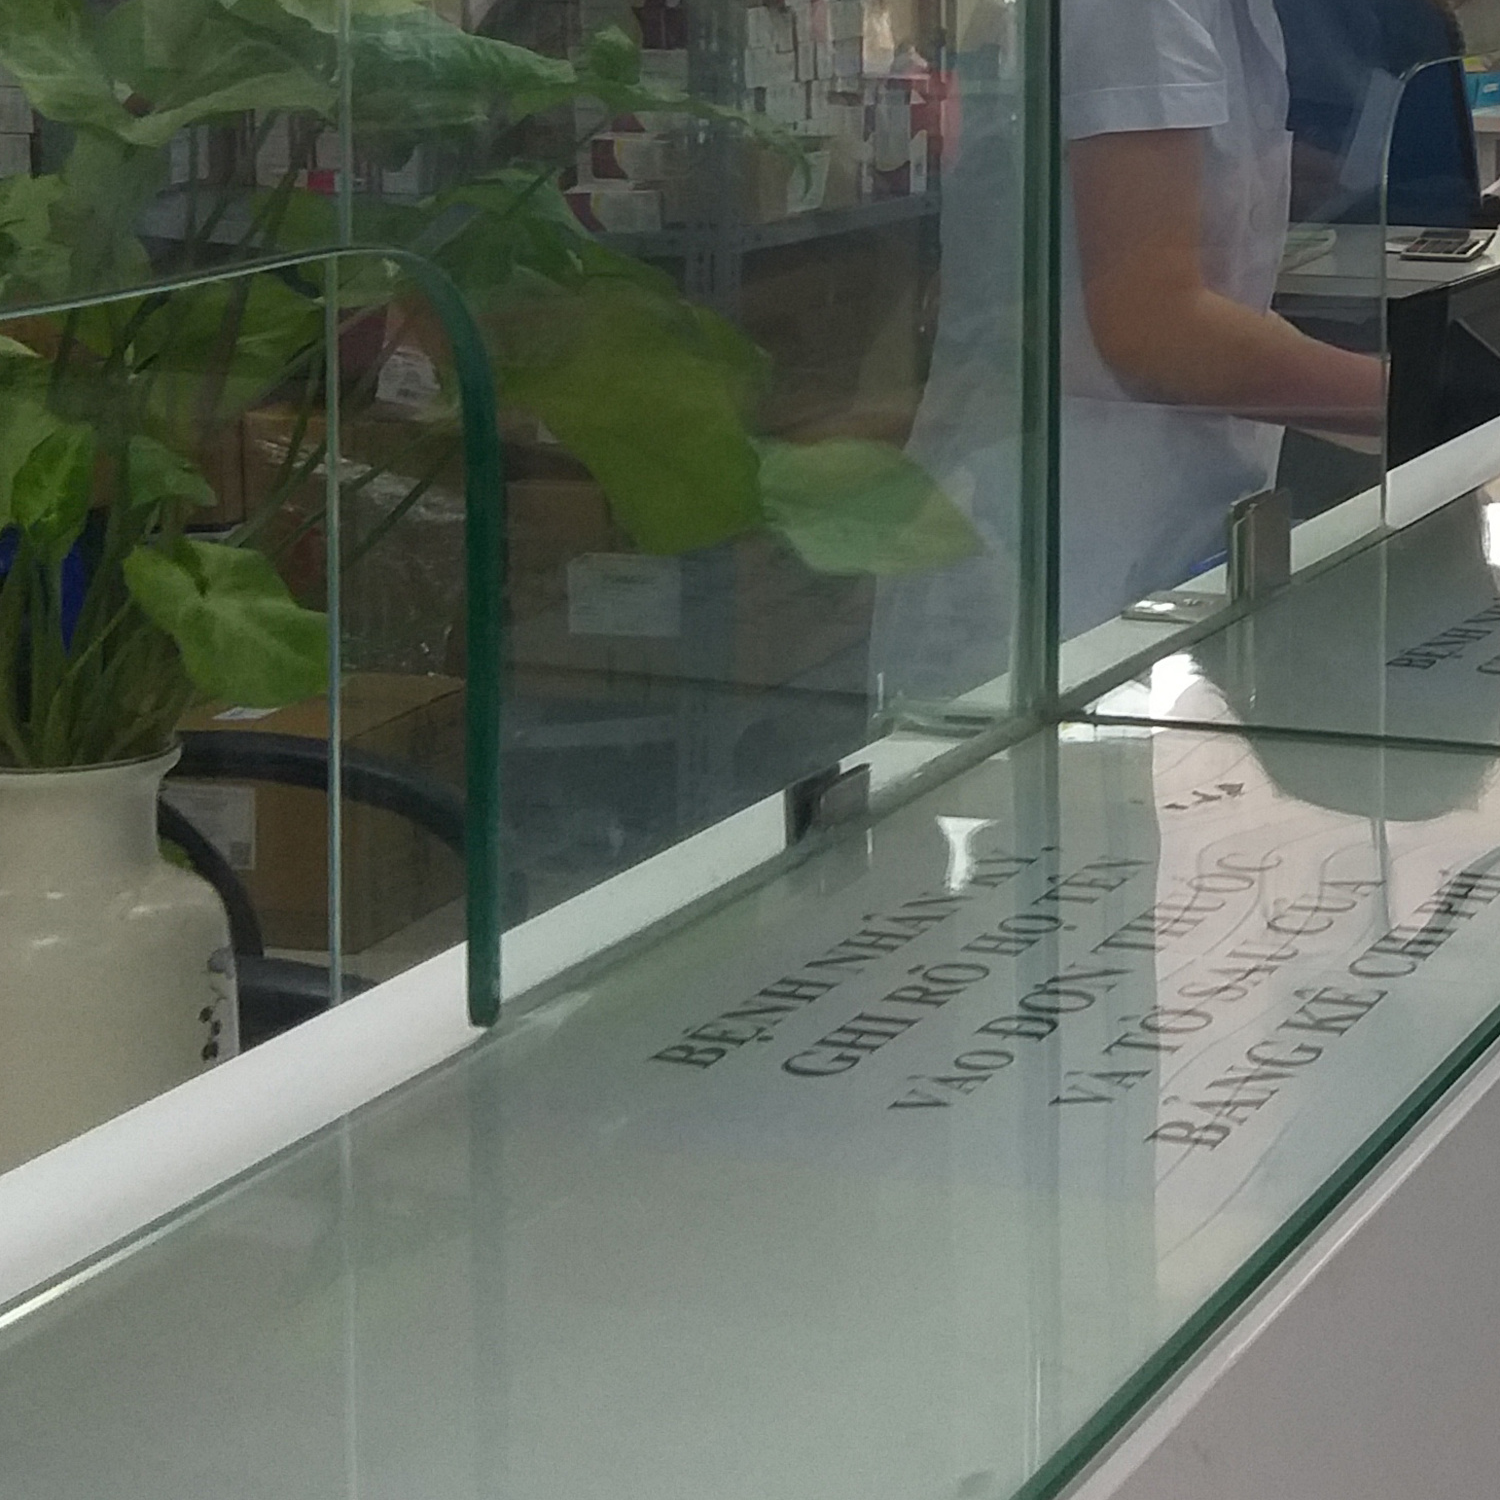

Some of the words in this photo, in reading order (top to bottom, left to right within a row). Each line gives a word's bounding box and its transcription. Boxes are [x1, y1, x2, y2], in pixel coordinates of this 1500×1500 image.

[650, 977, 841, 1069] BỆNH
[804, 892, 974, 973] NHÂN
[782, 1012, 923, 1077] GHI
[881, 963, 990, 1008] RÕ
[961, 915, 1077, 957] HỌ
[1031, 858, 1155, 904] TÊN
[888, 1051, 1014, 1109] VÀO
[974, 963, 1135, 1041] ĐƠN
[1090, 853, 1283, 953] THUỐC
[1049, 1069, 1153, 1107] VÀ
[1102, 1005, 1213, 1055] TỜ
[1177, 940, 1300, 1001] SAU
[1267, 880, 1387, 935] CỦA
[1144, 1040, 1323, 1150] BẢNG
[1277, 987, 1388, 1036] KÊ
[1350, 925, 1458, 978] CHI
